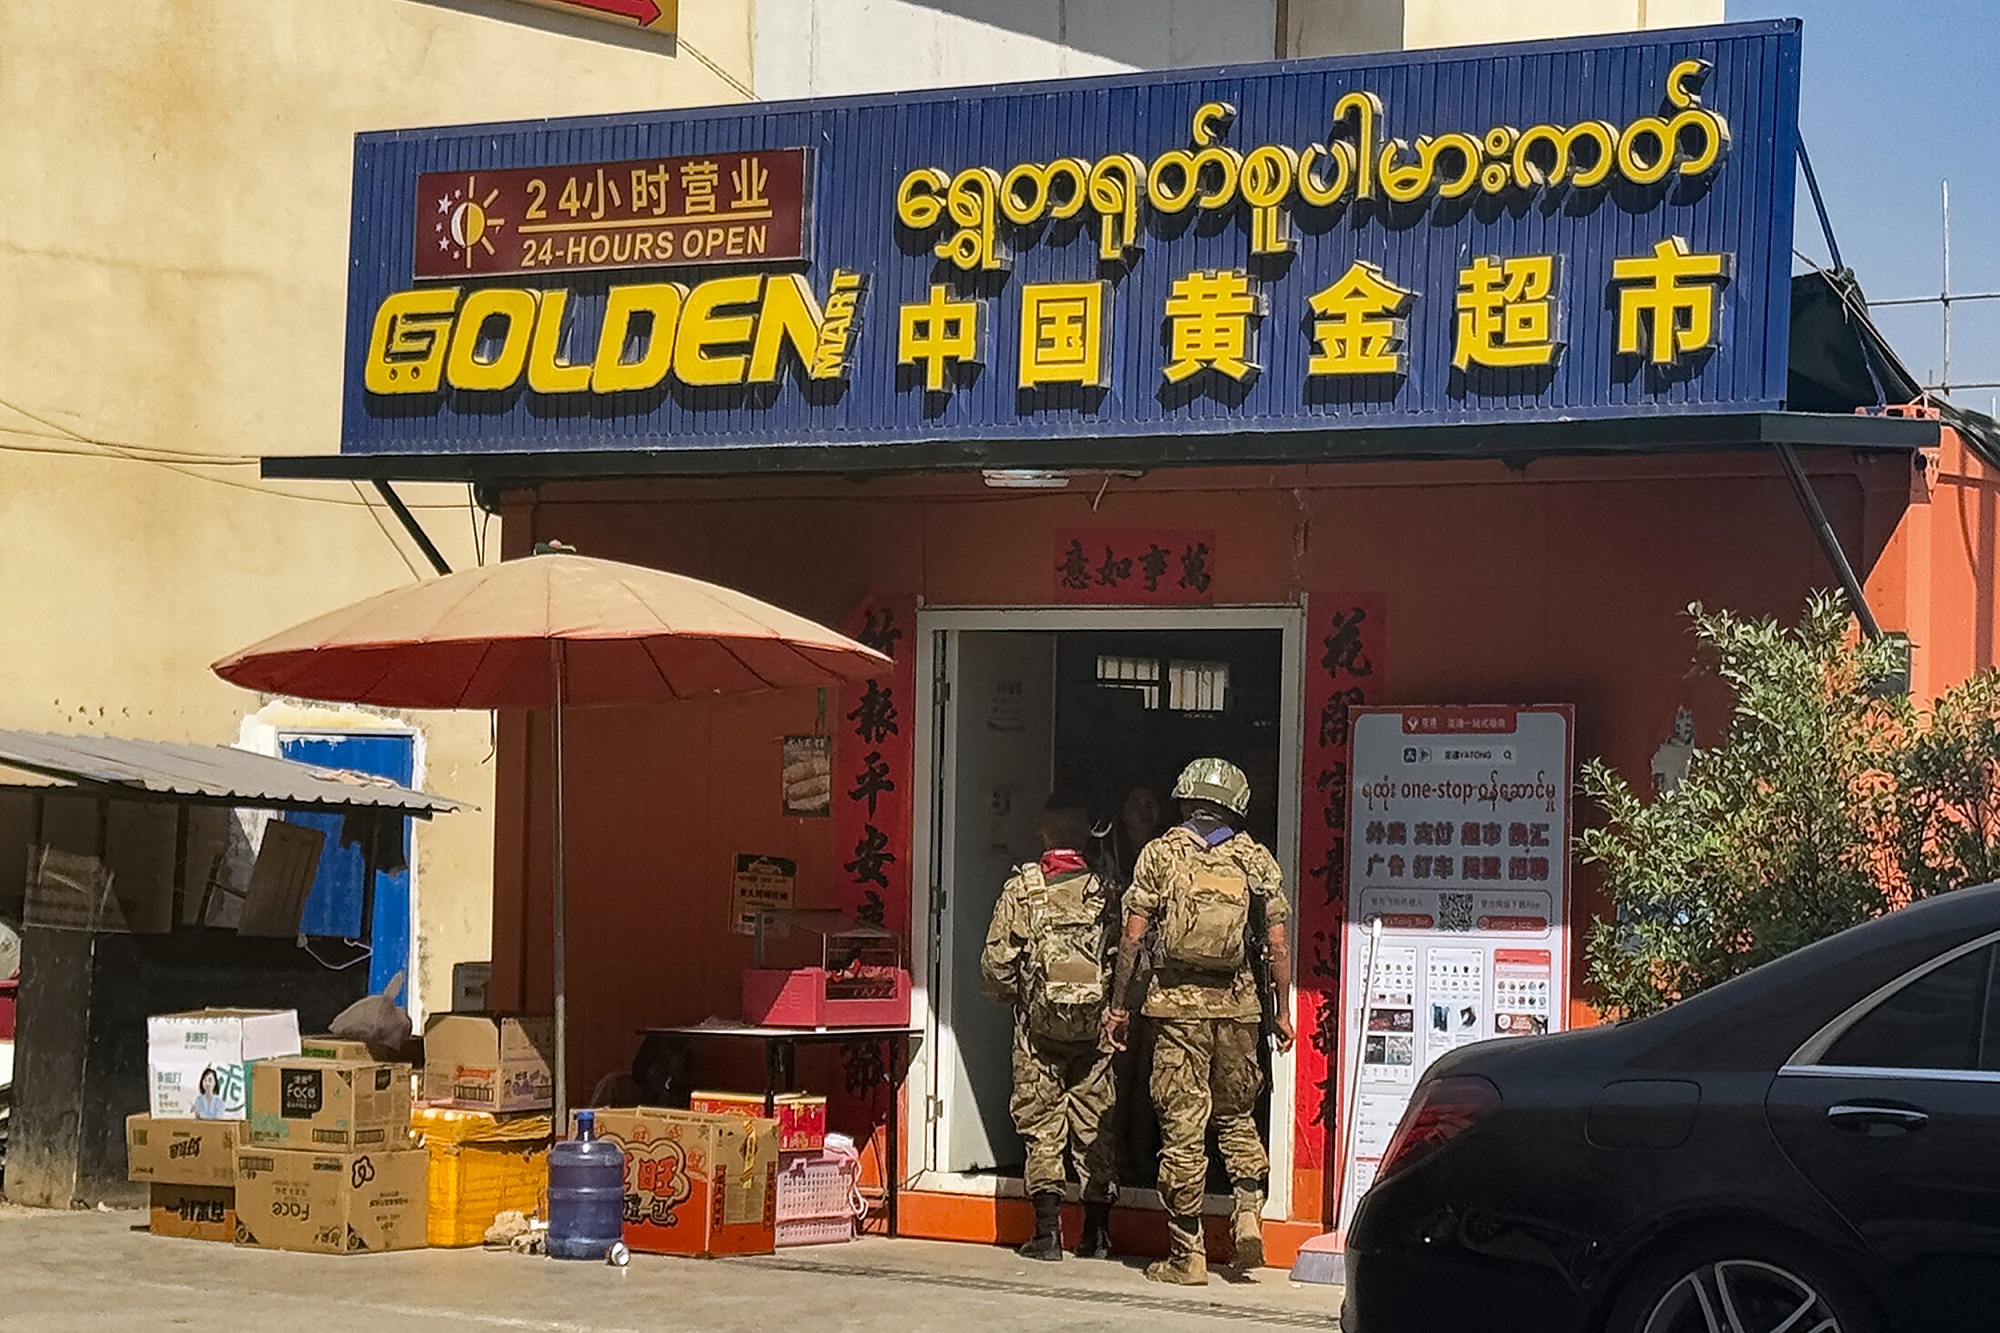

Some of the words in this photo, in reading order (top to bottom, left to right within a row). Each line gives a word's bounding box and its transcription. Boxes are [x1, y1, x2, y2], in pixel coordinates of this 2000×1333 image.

[525, 157, 770, 220] 24小时营业
[521, 231, 673, 268] 24-HOURS
[681, 225, 767, 259] OPEN
[364, 273, 822, 394] GOLDEN
[811, 268, 862, 380] MART
[897, 239, 1722, 391] 中国黄金超市
[1401, 780, 1472, 805] one-stop
